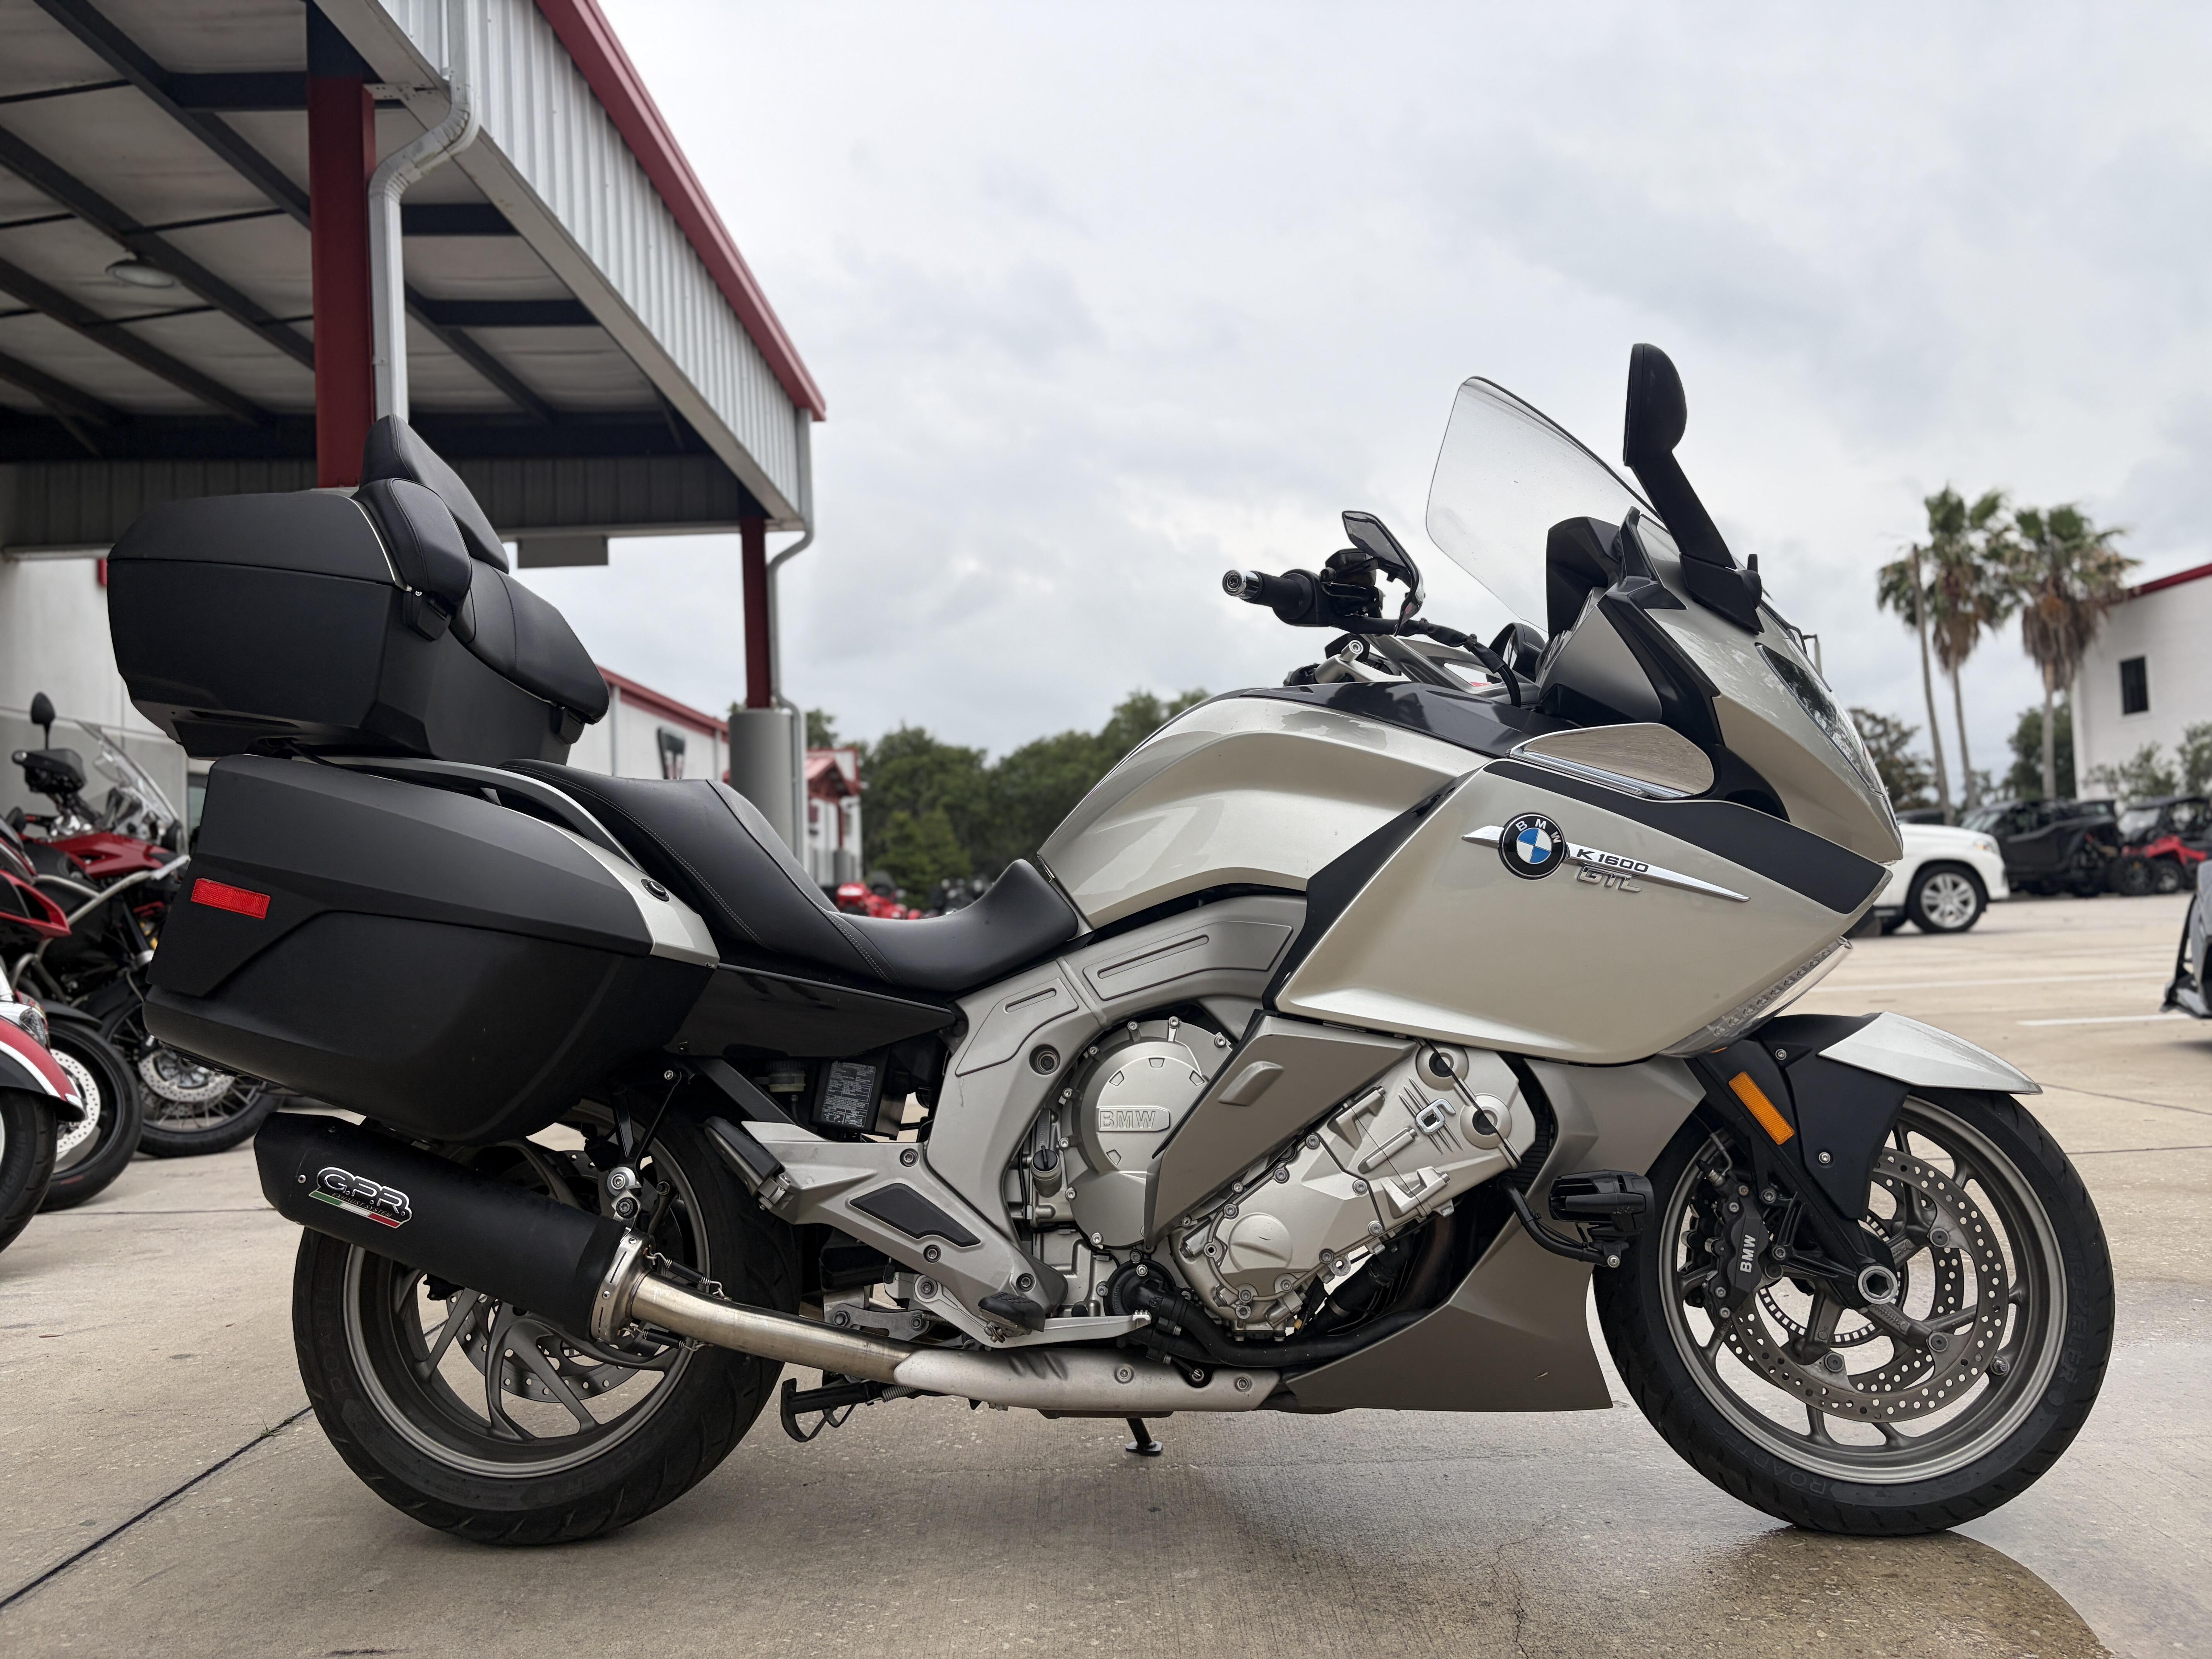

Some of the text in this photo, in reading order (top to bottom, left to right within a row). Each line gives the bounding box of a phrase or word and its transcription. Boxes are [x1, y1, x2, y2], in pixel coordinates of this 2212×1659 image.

[1515, 818, 1561, 843] BMW
[1576, 848, 1649, 873] K 1600
[1577, 866, 1642, 892] GTL
[1100, 1111, 1156, 1128] BMW
[331, 1192, 392, 1217] EXHAUST SYSTEM
[1740, 1234, 1756, 1273] BMW
[1712, 1419, 1826, 1495] ROADTEC
